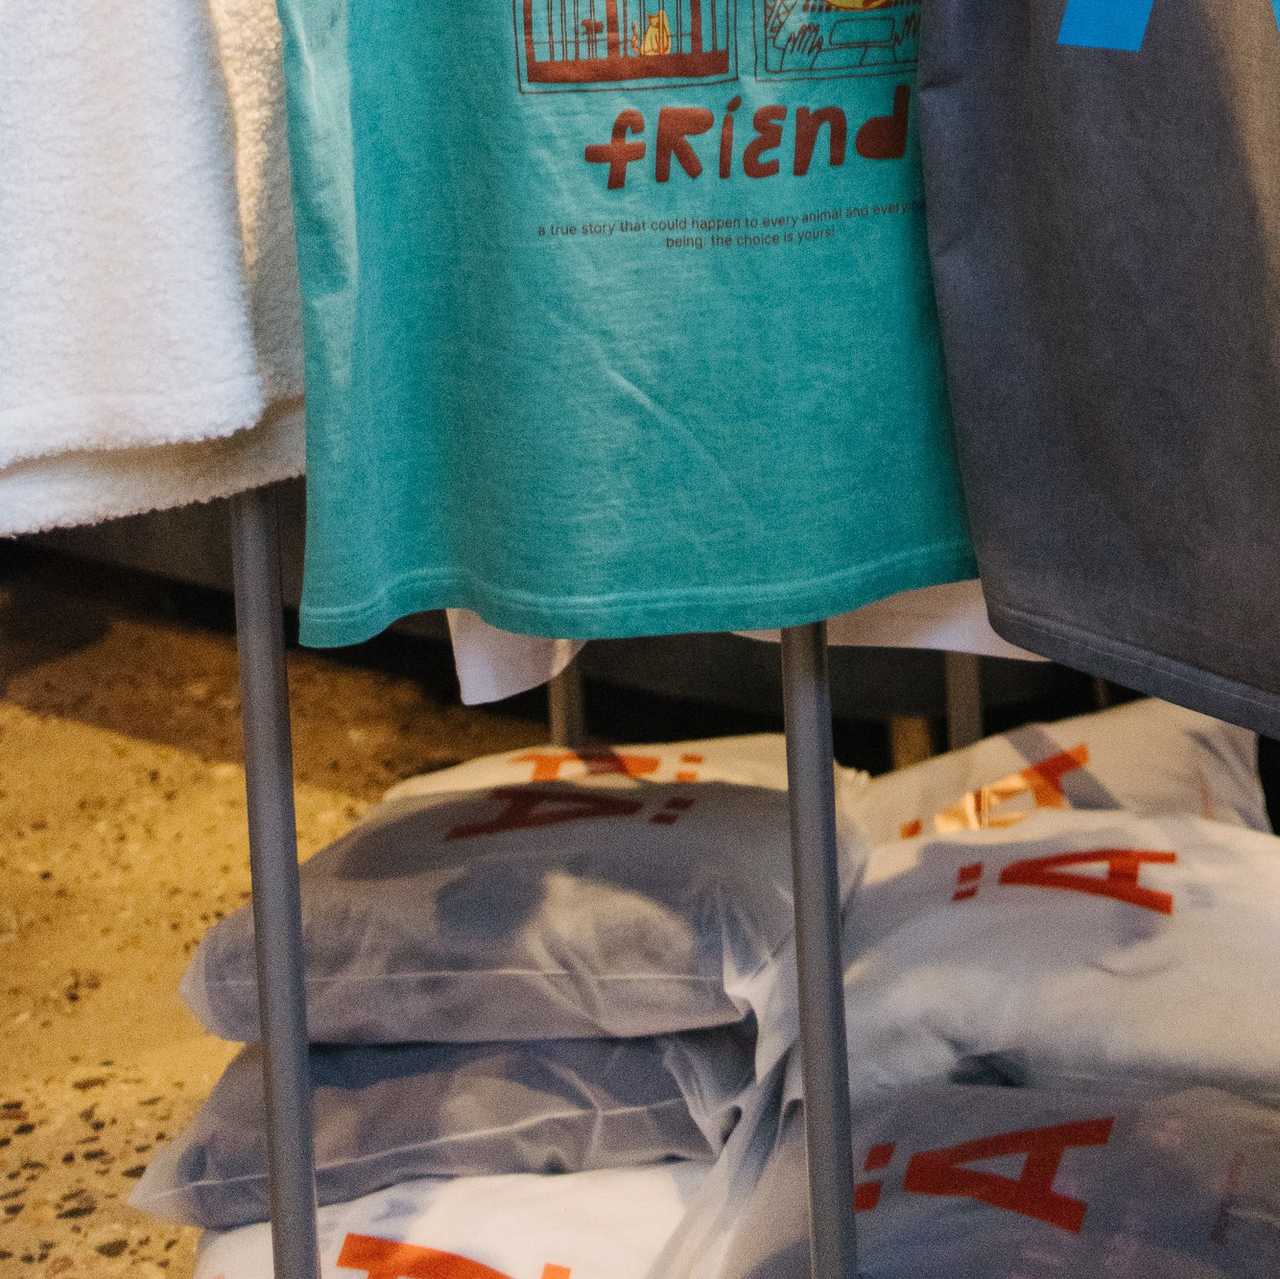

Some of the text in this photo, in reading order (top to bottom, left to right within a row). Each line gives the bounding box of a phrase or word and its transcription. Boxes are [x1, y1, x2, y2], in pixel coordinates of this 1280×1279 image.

[537, 225, 546, 237] a
[550, 224, 577, 237] true
[582, 222, 615, 236] story
[619, 220, 647, 233] that
[651, 218, 687, 232] could
[691, 216, 741, 232] happen
[745, 217, 759, 229] to
[762, 216, 799, 229] every
[802, 208, 843, 224] animal
[846, 205, 869, 218] and
[872, 202, 909, 216] every
[711, 234, 732, 247] the
[736, 233, 780, 247] choice
[783, 231, 794, 243] is
[797, 226, 836, 242] yours!
